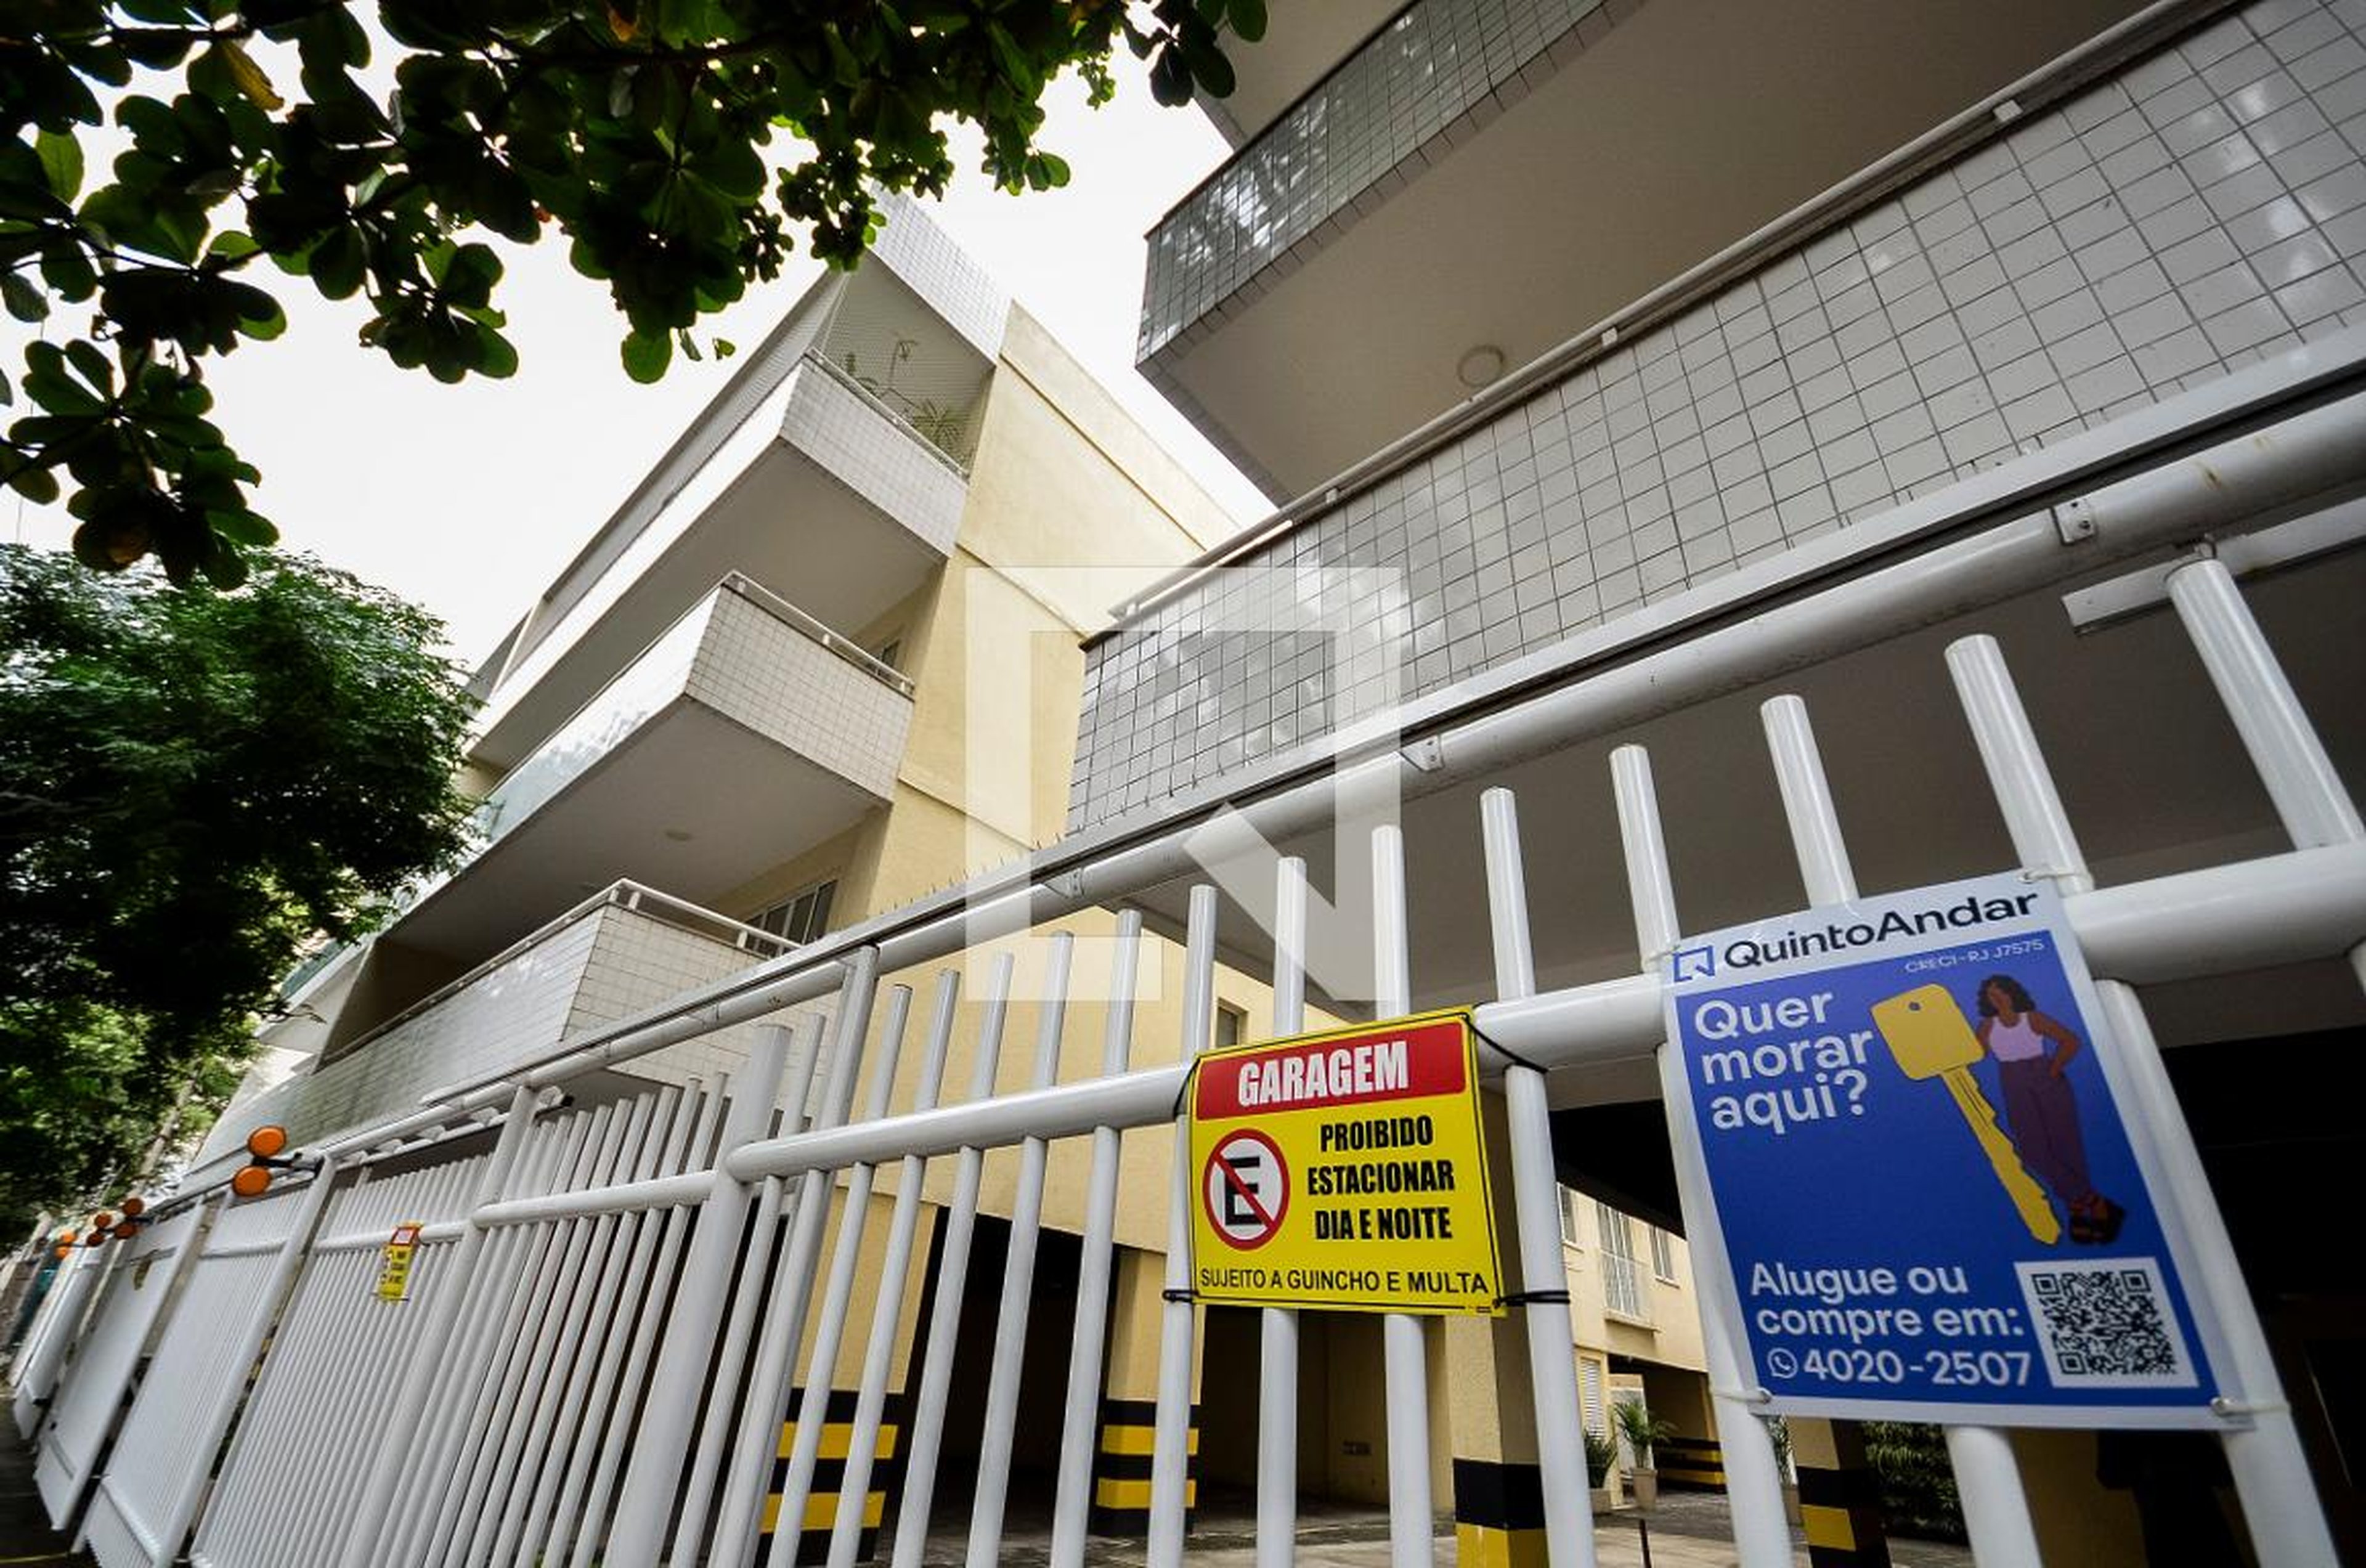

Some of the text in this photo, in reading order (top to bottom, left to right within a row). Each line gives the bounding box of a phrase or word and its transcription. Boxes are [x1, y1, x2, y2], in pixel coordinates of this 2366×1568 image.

[1725, 892, 2038, 970] QuintoAndar
[1696, 992, 1834, 1040] Quer
[1238, 1041, 1410, 1107] GARAGEM
[1701, 1030, 1874, 1084] morar
[1710, 1069, 1868, 1135] aqui?
[1320, 1115, 1434, 1152] PROIBIDO
[1307, 1160, 1455, 1195] ESTACIONAR
[1315, 1206, 1453, 1240] DIA E NOITE
[1201, 1268, 1489, 1293] SUJEITO A GUINCHO E MULTA
[1750, 1263, 1969, 1304] Alugue ou
[1756, 1307, 2025, 1344] compre em:
[1803, 1348, 2031, 1386] 4020-2507
